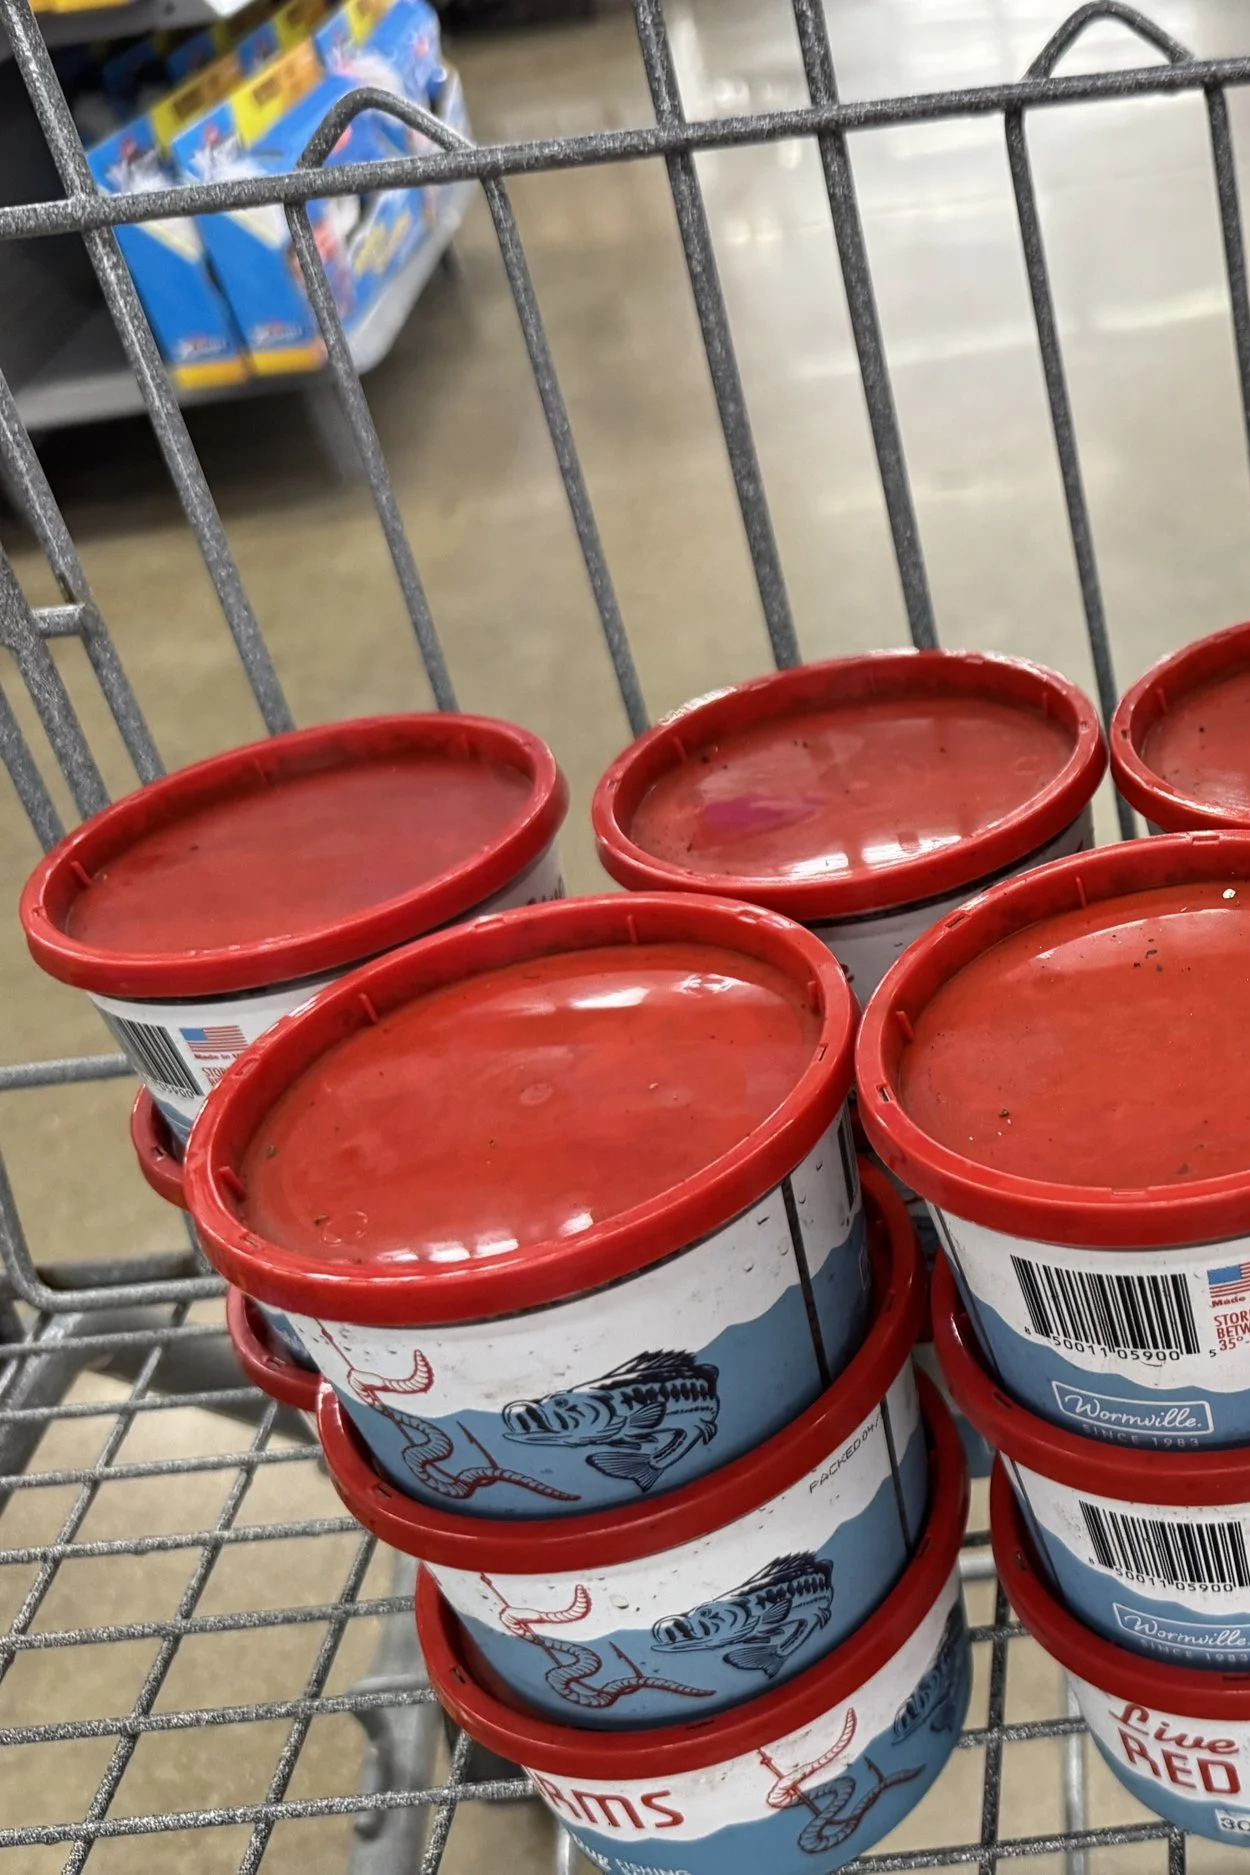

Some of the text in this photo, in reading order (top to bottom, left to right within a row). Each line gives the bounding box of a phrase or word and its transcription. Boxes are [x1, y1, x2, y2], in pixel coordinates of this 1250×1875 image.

[1211, 1296, 1247, 1308] Made
[1117, 1350, 1180, 1362] 05900
[1208, 1348, 1217, 1358] 5
[1082, 1423, 1200, 1448] SINCE 1983
[808, 1438, 862, 1495] PACKED
[1175, 1582, 1233, 1593] 05900
[1108, 1704, 1240, 1755] Live
[1118, 1727, 1241, 1794] RED
[535, 1774, 684, 1829] RMS
